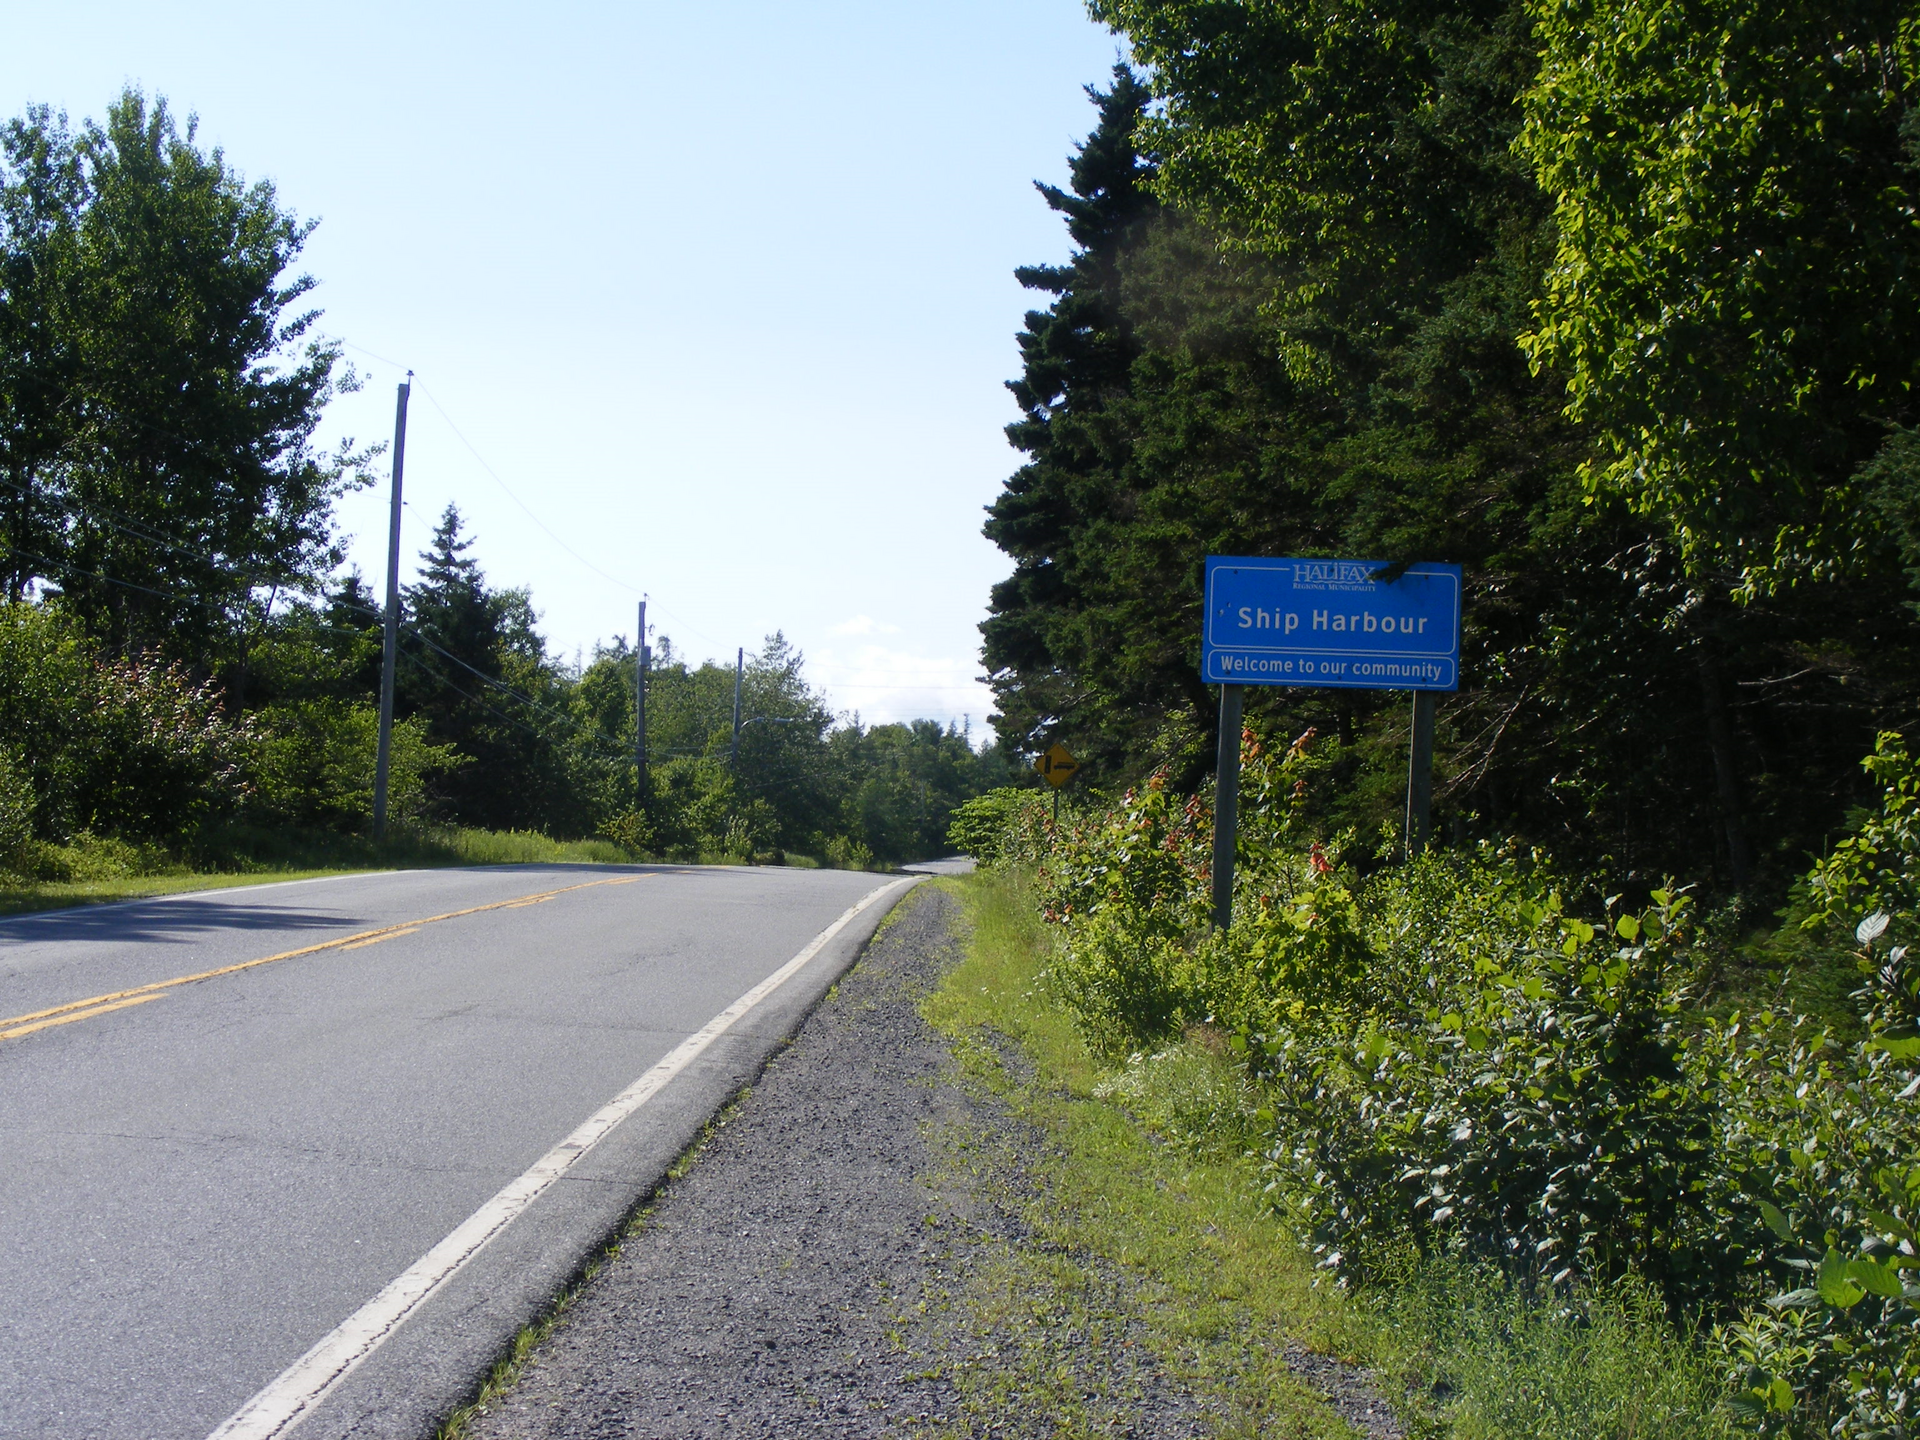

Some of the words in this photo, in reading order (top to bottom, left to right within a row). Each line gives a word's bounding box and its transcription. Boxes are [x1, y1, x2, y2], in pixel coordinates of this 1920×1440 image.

[1328, 584, 1376, 592] MUNICIPALITY
[1238, 606, 1299, 635] Ship
[1312, 609, 1428, 634] Harbour
[1220, 655, 1293, 673] Welcome
[1299, 658, 1314, 674] to
[1320, 662, 1347, 675] our
[1352, 662, 1442, 681] community
